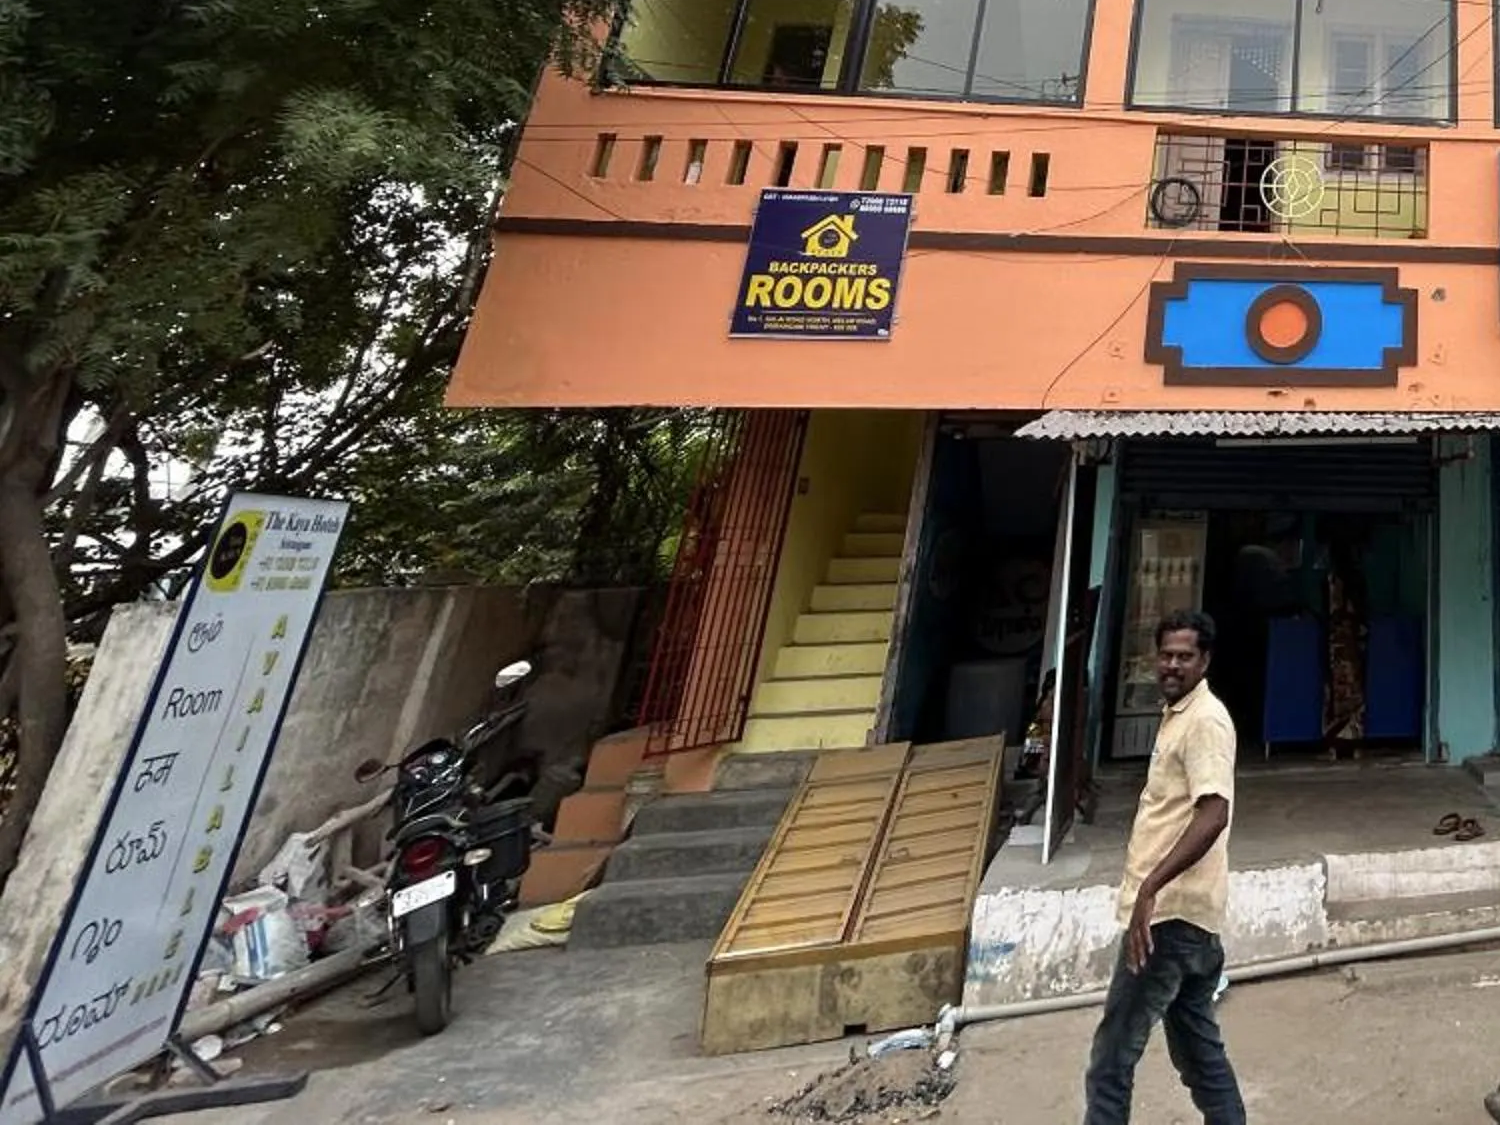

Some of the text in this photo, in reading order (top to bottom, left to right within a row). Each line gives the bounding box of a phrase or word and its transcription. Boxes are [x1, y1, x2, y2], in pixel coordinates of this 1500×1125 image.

[768, 261, 878, 276] BACKPACKERS
[745, 275, 892, 311] ROOMS
[161, 687, 224, 720] Room
